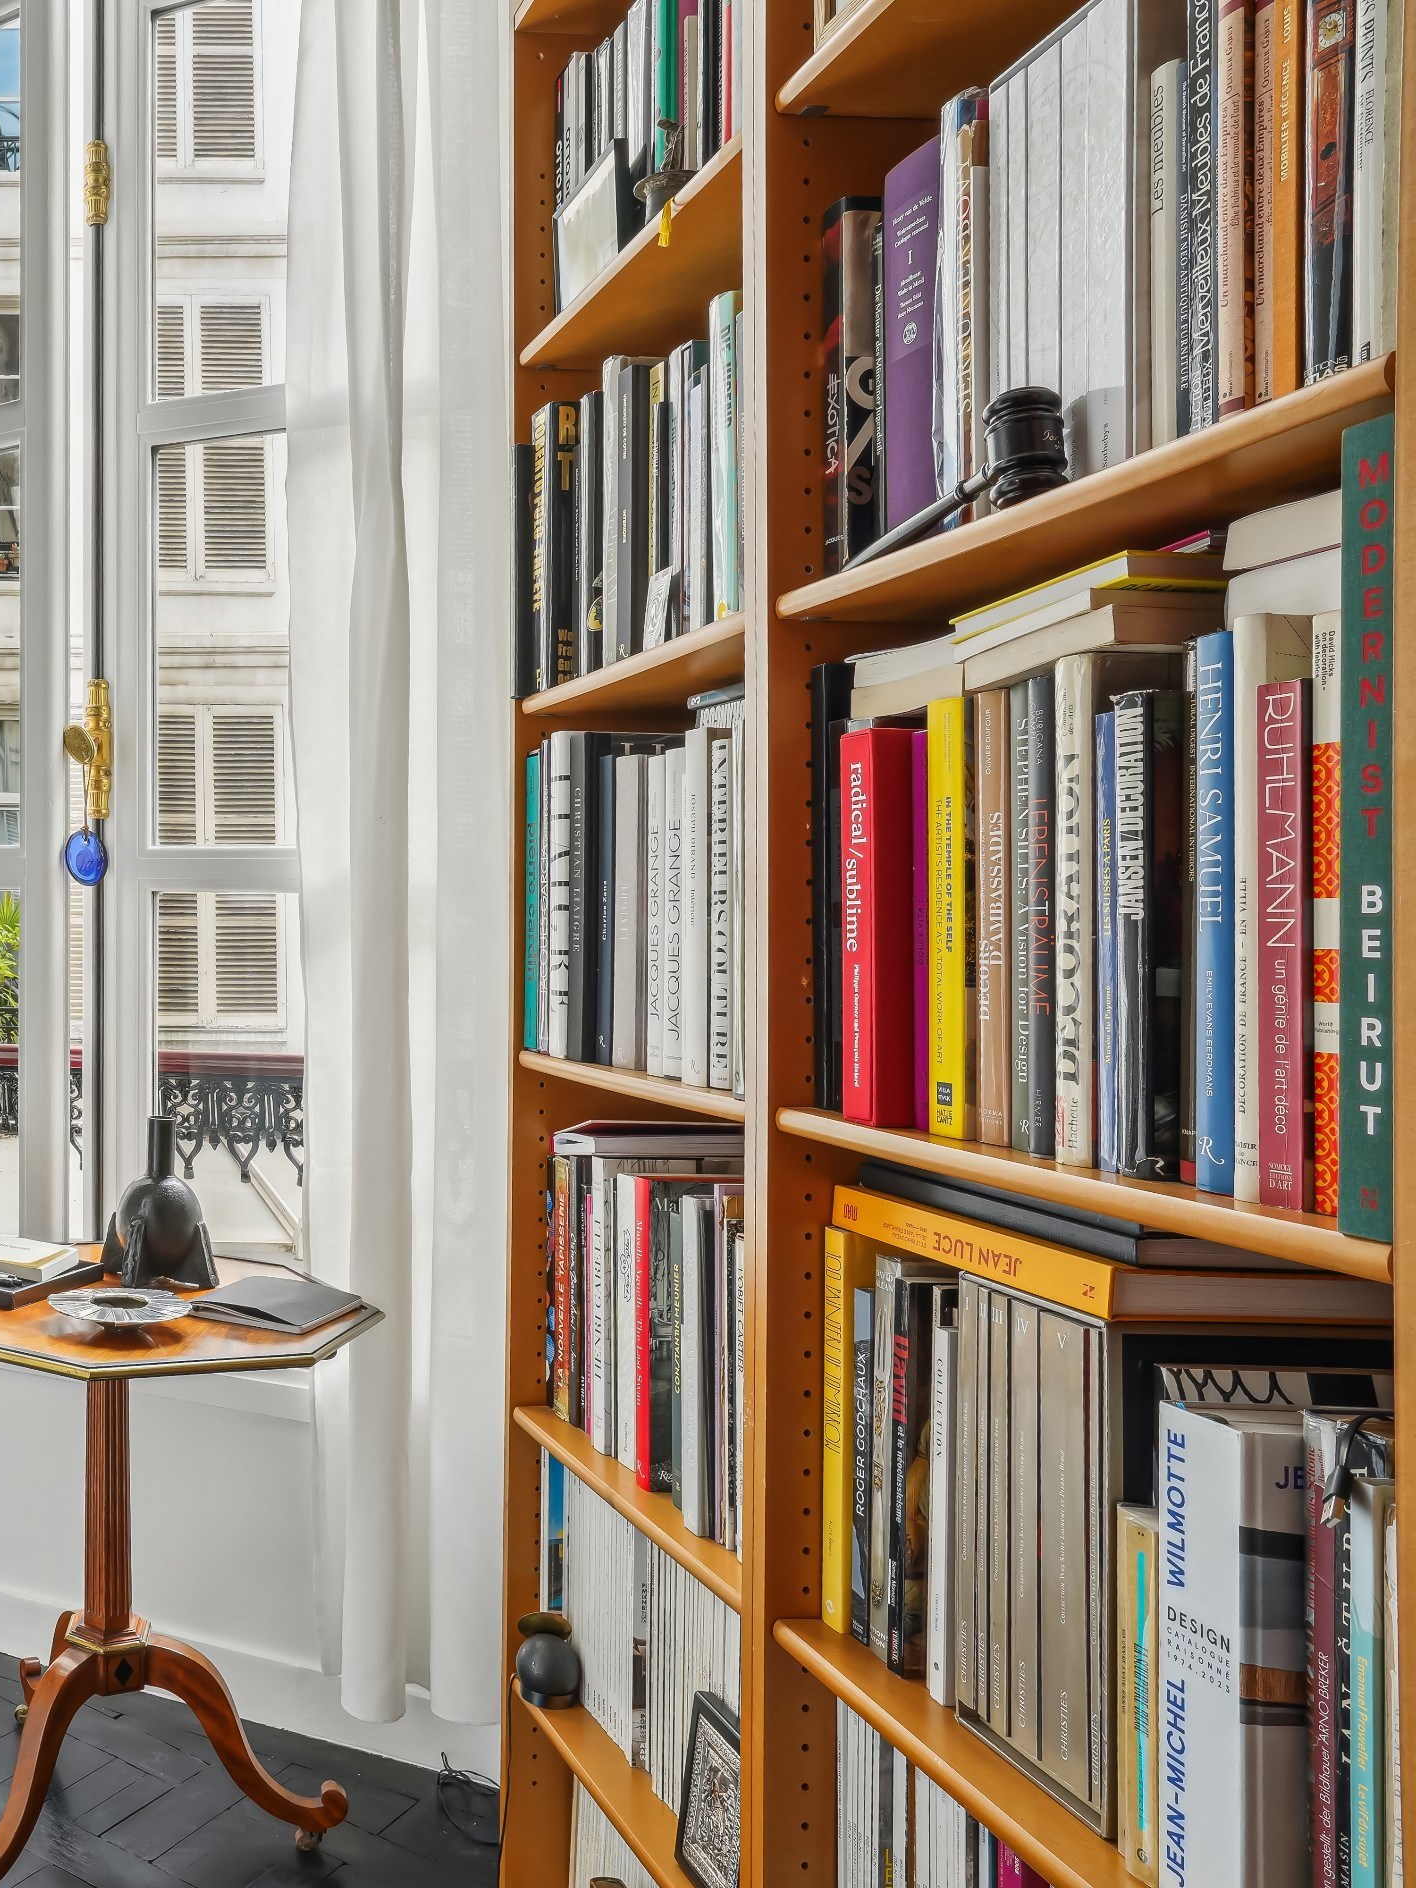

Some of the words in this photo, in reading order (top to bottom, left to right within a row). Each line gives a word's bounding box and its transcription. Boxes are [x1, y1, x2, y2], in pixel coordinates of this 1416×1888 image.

[1282, 5, 1292, 44] LOUIS
[1190, 73, 1210, 107] de
[1278, 58, 1290, 117] RÉGENCE
[1150, 84, 1164, 175] meubles
[1220, 105, 1231, 158] Empires
[1255, 100, 1267, 154] Empires
[1364, 88, 1375, 147] FLORENCE
[1191, 111, 1211, 219] Meubles
[1220, 159, 1229, 189] deux
[1255, 154, 1265, 185] deux
[1280, 120, 1290, 182] MOBILIER
[1150, 177, 1164, 217] Les
[1179, 193, 1188, 240] DANISH
[1220, 191, 1229, 222] entre
[1255, 186, 1265, 219] entre
[1219, 225, 1229, 287] marchand
[1255, 221, 1265, 283] marchand
[874, 283, 882, 297] Die
[1178, 241, 1188, 322] NEO-ANTIQUE
[1192, 214, 1211, 357] Merveilleux
[1219, 288, 1229, 308] Un
[1255, 288, 1265, 308] Un
[875, 340, 883, 357] des
[1179, 324, 1188, 392] FURNITURE
[875, 358, 883, 405] Münchner
[825, 373, 842, 475] EXOTICA
[875, 406, 883, 456] Jugendstils
[1101, 422, 1110, 468] Sotheby's
[1328, 630, 1336, 653] David
[1328, 654, 1336, 678] Hicks
[1357, 455, 1390, 840] MODERNIST
[1036, 709, 1044, 765] BURIGANA
[1199, 661, 1223, 776] HENRI
[1016, 718, 1029, 821] STEPHEN
[935, 799, 943, 818] THE
[945, 796, 953, 808] IN
[945, 811, 953, 833] THE
[1189, 765, 1197, 836] INTERNATIONAL
[1265, 692, 1296, 948] RUHLMANN
[573, 786, 582, 879] CHRISTIAN
[935, 821, 943, 867] ARTIST'S
[527, 821, 537, 896] pierre
[650, 824, 660, 917] GRANGE
[668, 817, 682, 926] GRANGE
[945, 835, 953, 880] TEMPLE
[1016, 826, 1029, 896] SILLS:
[1188, 836, 1197, 882] INTERIORS
[1199, 788, 1223, 933] SAMUEL
[935, 869, 943, 928] RESIDENCE
[945, 882, 953, 898] OF
[945, 900, 953, 923] THE
[988, 811, 1004, 966] D'AMBASSADES
[1017, 901, 1029, 916] A
[1029, 798, 1055, 1016] LEBENSTRÄUME
[1238, 877, 1247, 913] VILLE
[527, 902, 537, 983] cardin
[572, 886, 581, 953] LIAIGRE
[935, 932, 943, 945] AS
[945, 925, 953, 953] SELF
[1238, 919, 1247, 937] EN
[650, 924, 661, 1021] JACQUES
[936, 947, 943, 955] A
[1017, 923, 1029, 979] Vision
[1274, 959, 1288, 979] un
[667, 932, 682, 1043] JACQUES
[1017, 986, 1029, 1015] for
[1238, 955, 1247, 1005] FRANCE
[1238, 1010, 1247, 1028] DE
[1271, 984, 1290, 1028] génie
[1360, 883, 1384, 1136] BEIRUT
[936, 1027, 943, 1044] OF
[1015, 1019, 1029, 1084] Design
[1274, 1034, 1290, 1054] de
[1274, 1060, 1290, 1090] l'art
[1034, 1088, 1043, 1127] HIRMER
[1067, 1097, 1079, 1149] Hachette
[1274, 1095, 1290, 1135] déco
[1269, 1179, 1293, 1192] D'ART
[557, 1193, 565, 1277] TAPISSERIE
[932, 1231, 974, 1263] LUCE
[824, 1251, 842, 1280] 100
[978, 1246, 1023, 1278] JEAN
[557, 1283, 566, 1362] NOUVELLE
[824, 1285, 842, 1351] PAINTERS
[980, 1303, 988, 1319] II
[991, 1306, 1003, 1325] III
[1017, 1317, 1029, 1335] IV
[1057, 1332, 1067, 1350] V
[557, 1369, 566, 1388] LA
[855, 1351, 866, 1451] GODCHAUX
[892, 1333, 909, 1425] David
[824, 1372, 842, 1455] TOMORROW
[896, 1425, 905, 1438] et
[936, 1357, 944, 1460] COLLECTION
[896, 1438, 905, 1449] le
[855, 1456, 866, 1517] ROGER
[895, 1450, 905, 1524] néoclassicisme
[1166, 1427, 1187, 1589] WILMOTTE
[960, 1619, 968, 1683] CHRISTIE'S
[1166, 1626, 1231, 1668] CATALOGUE
[1167, 1605, 1231, 1654] DESIGN
[978, 1630, 986, 1696] CHRISTIE'S
[993, 1642, 1001, 1709] CHRISTIE'S
[1167, 1638, 1231, 1681] RAISONNÉ
[1317, 1651, 1330, 1699] BREKER
[1357, 1655, 1368, 1709] Emanuel
[1018, 1659, 1026, 1728] CHRISTIE'S
[1060, 1689, 1068, 1761] CHRISTIE'S
[1318, 1701, 1331, 1745] ARNO
[1357, 1710, 1368, 1772] Proweller
[1091, 1711, 1099, 1785] CHRISTIE'S
[1166, 1677, 1187, 1888] JEAN-MICHEL
[1317, 1745, 1332, 1804] Bildhauer
[1357, 1783, 1368, 1797] Le
[1319, 1806, 1332, 1828] der
[1357, 1800, 1368, 1818] vif
[1357, 1818, 1368, 1835] du
[1321, 1830, 1334, 1879] gestellt:
[1355, 1836, 1368, 1868] sujet
